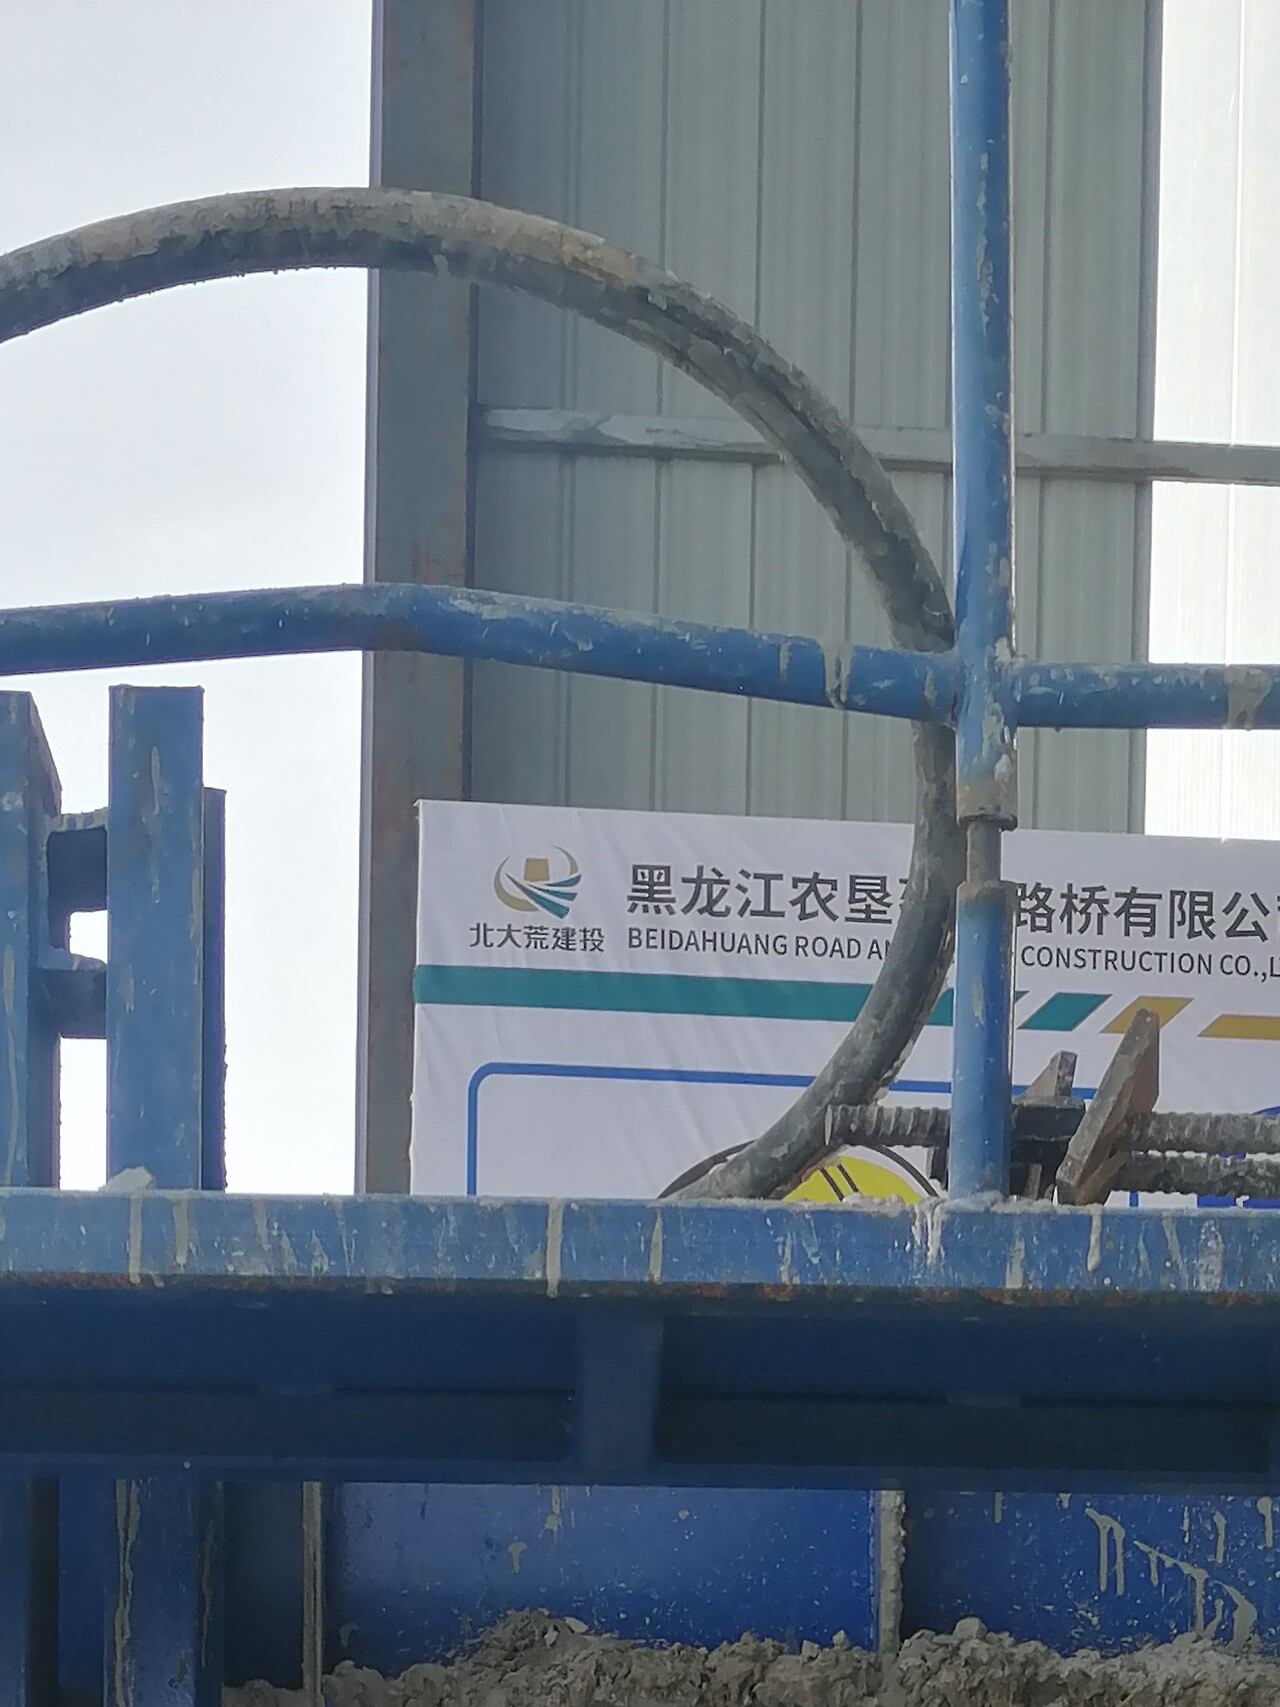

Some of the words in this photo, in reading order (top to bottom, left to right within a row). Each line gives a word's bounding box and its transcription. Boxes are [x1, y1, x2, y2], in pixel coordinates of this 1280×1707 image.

[469, 922, 605, 952] 北大荒建投
[627, 926, 788, 956] BEIDAHUANG
[794, 935, 862, 960] ROAD
[1020, 945, 1213, 975] CONSTRUCTION
